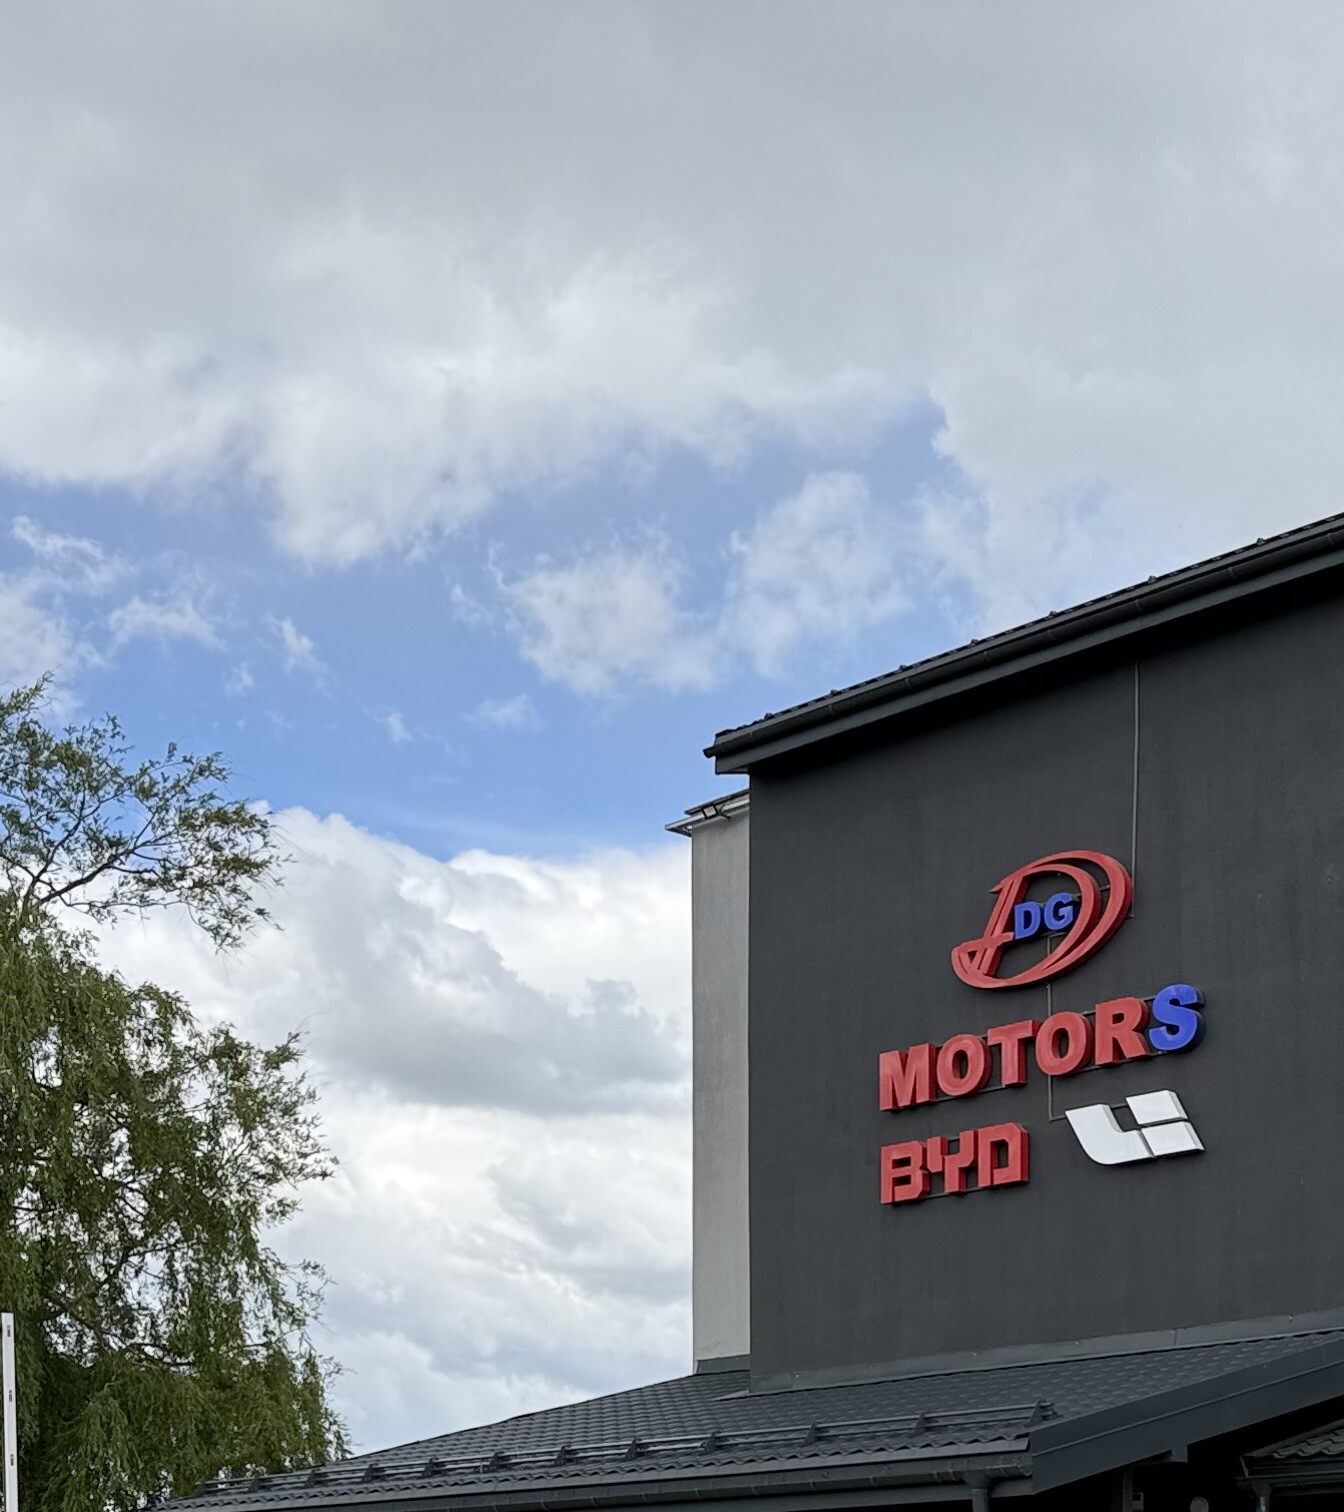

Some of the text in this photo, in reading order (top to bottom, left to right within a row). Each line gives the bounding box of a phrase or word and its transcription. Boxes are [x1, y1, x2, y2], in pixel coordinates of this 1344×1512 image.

[1014, 892, 1074, 940] DG
[879, 984, 1202, 1111] MOTORS
[880, 1122, 1030, 1204] BYD
